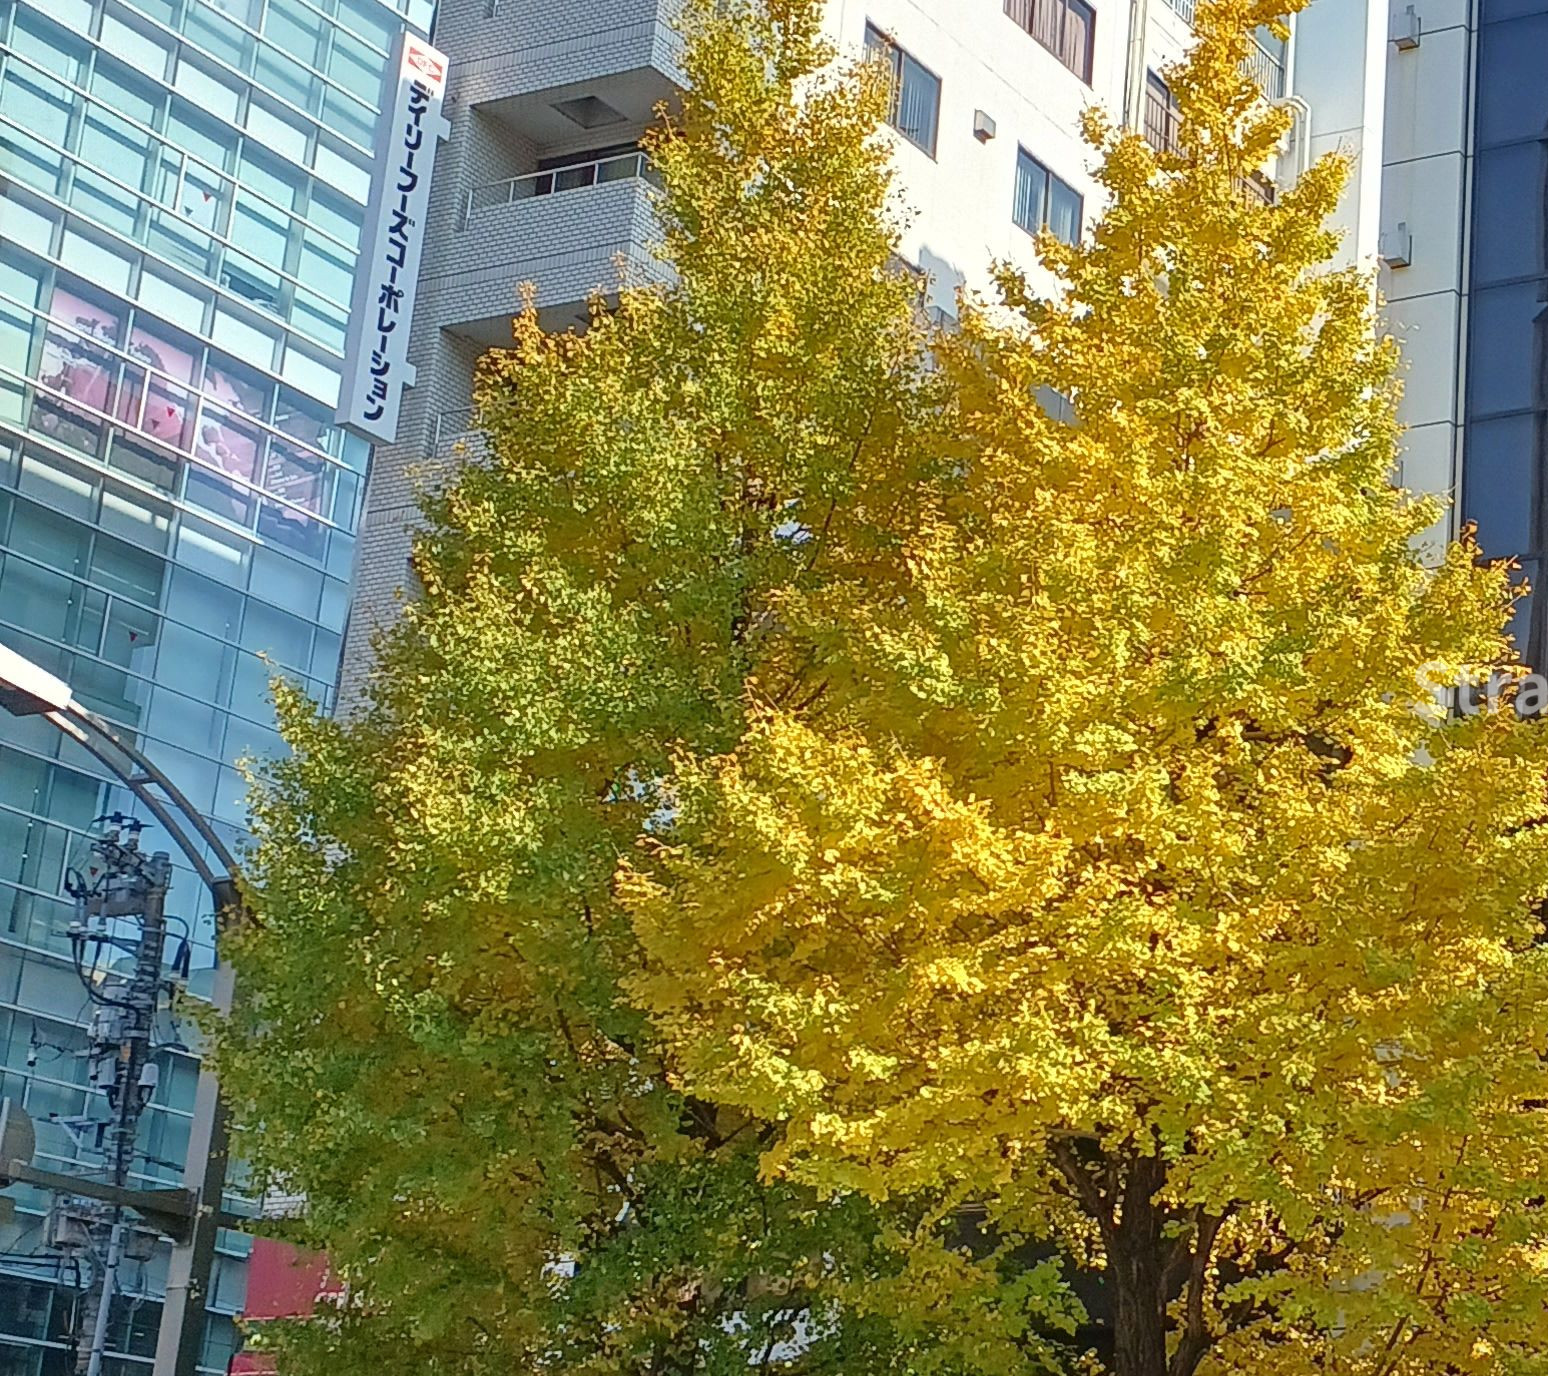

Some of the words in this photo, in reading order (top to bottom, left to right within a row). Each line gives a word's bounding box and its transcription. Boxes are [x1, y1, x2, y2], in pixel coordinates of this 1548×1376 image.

[363, 79, 435, 421] デイリーフーズコーポレーション
